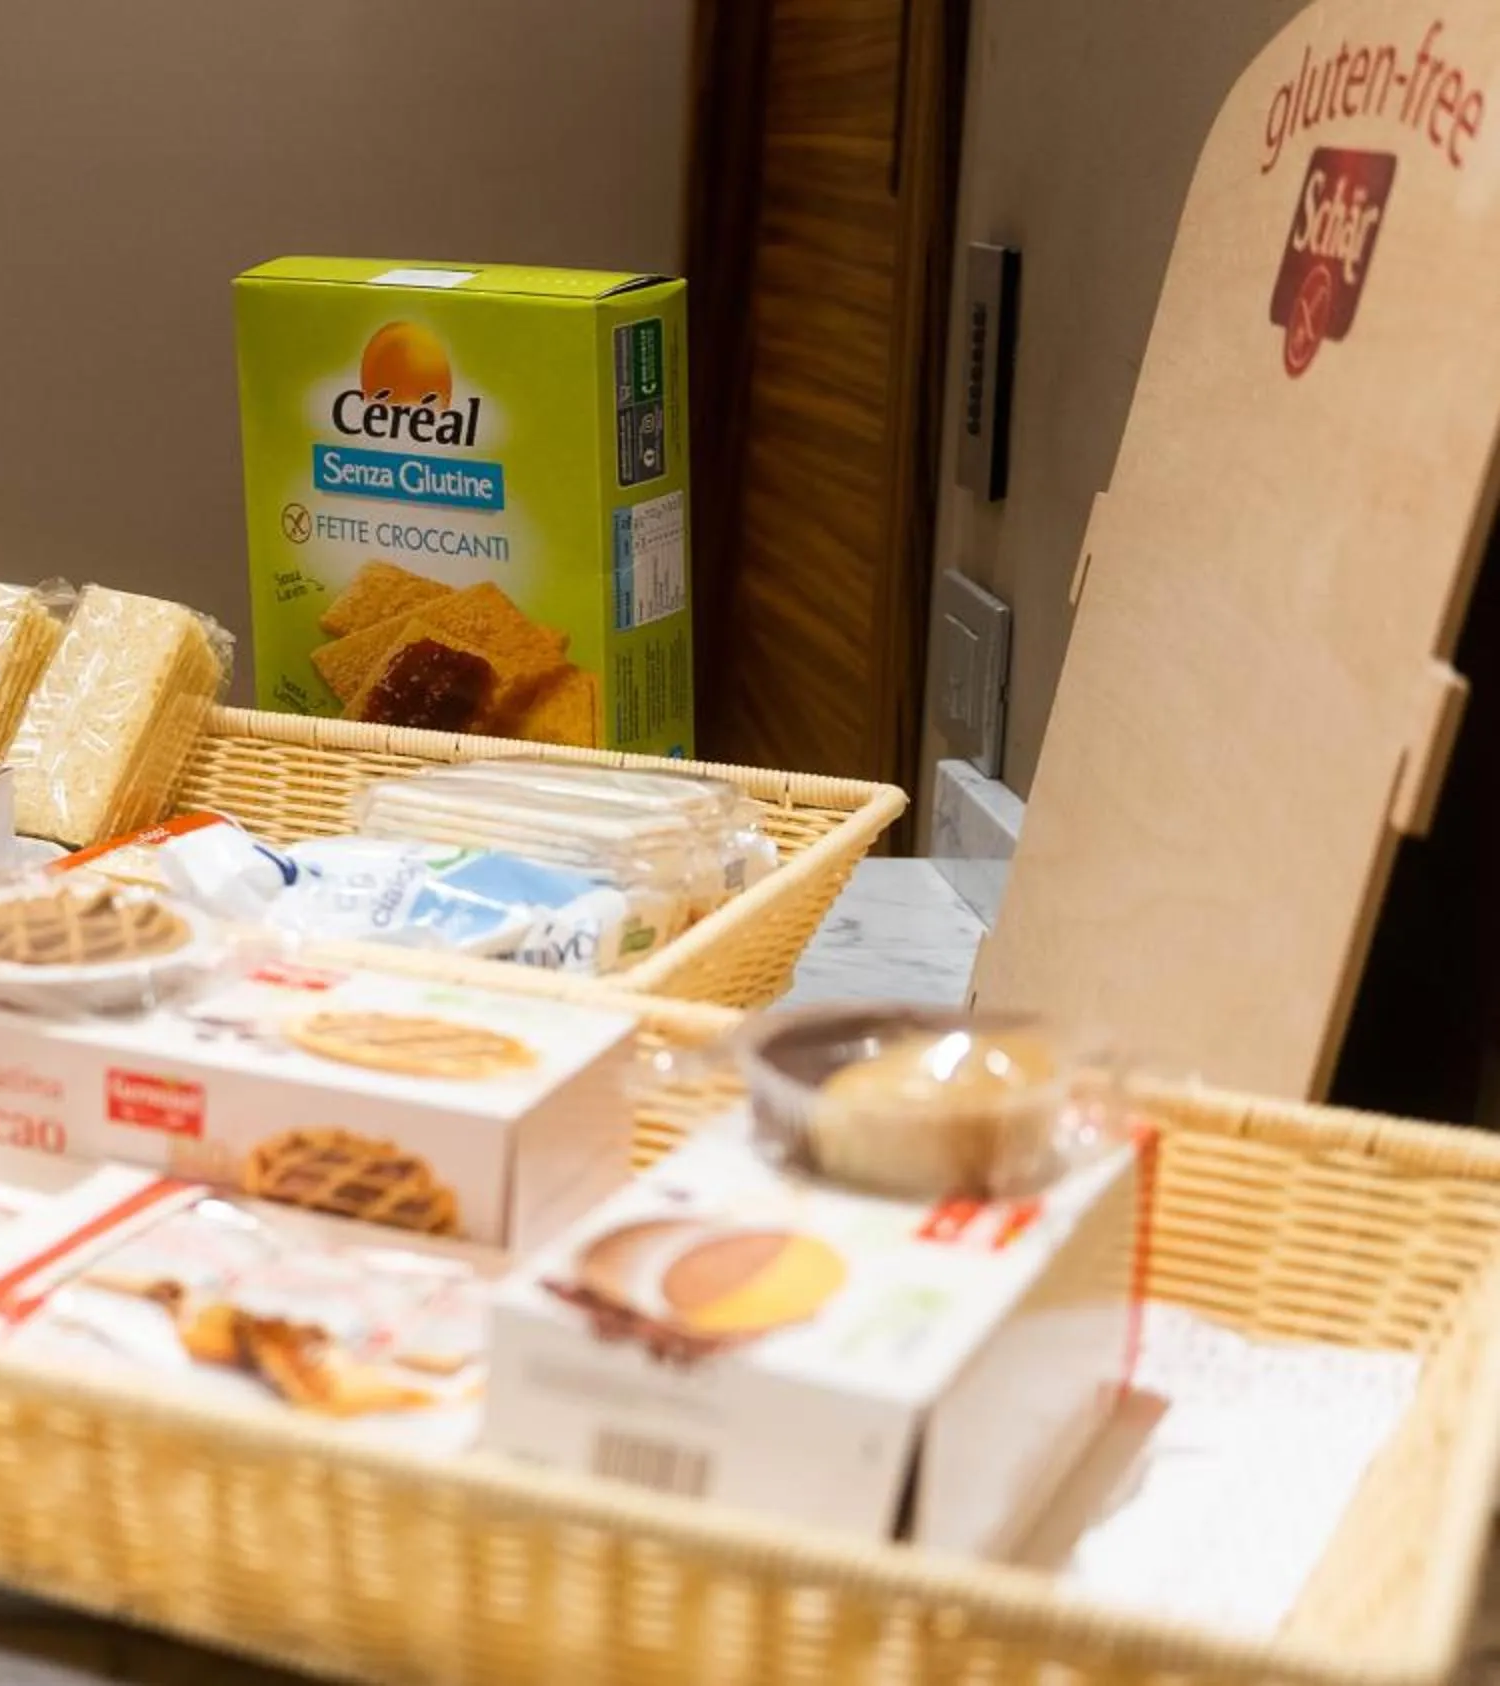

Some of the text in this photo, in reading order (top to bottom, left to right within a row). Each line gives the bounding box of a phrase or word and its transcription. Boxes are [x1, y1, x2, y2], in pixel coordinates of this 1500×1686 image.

[1261, 19, 1484, 176] gluten-free
[1293, 168, 1379, 285] Schär
[332, 388, 481, 447] Céréal
[323, 452, 494, 499] Senza Glutine
[316, 514, 510, 561] FETTE CROCCANTI
